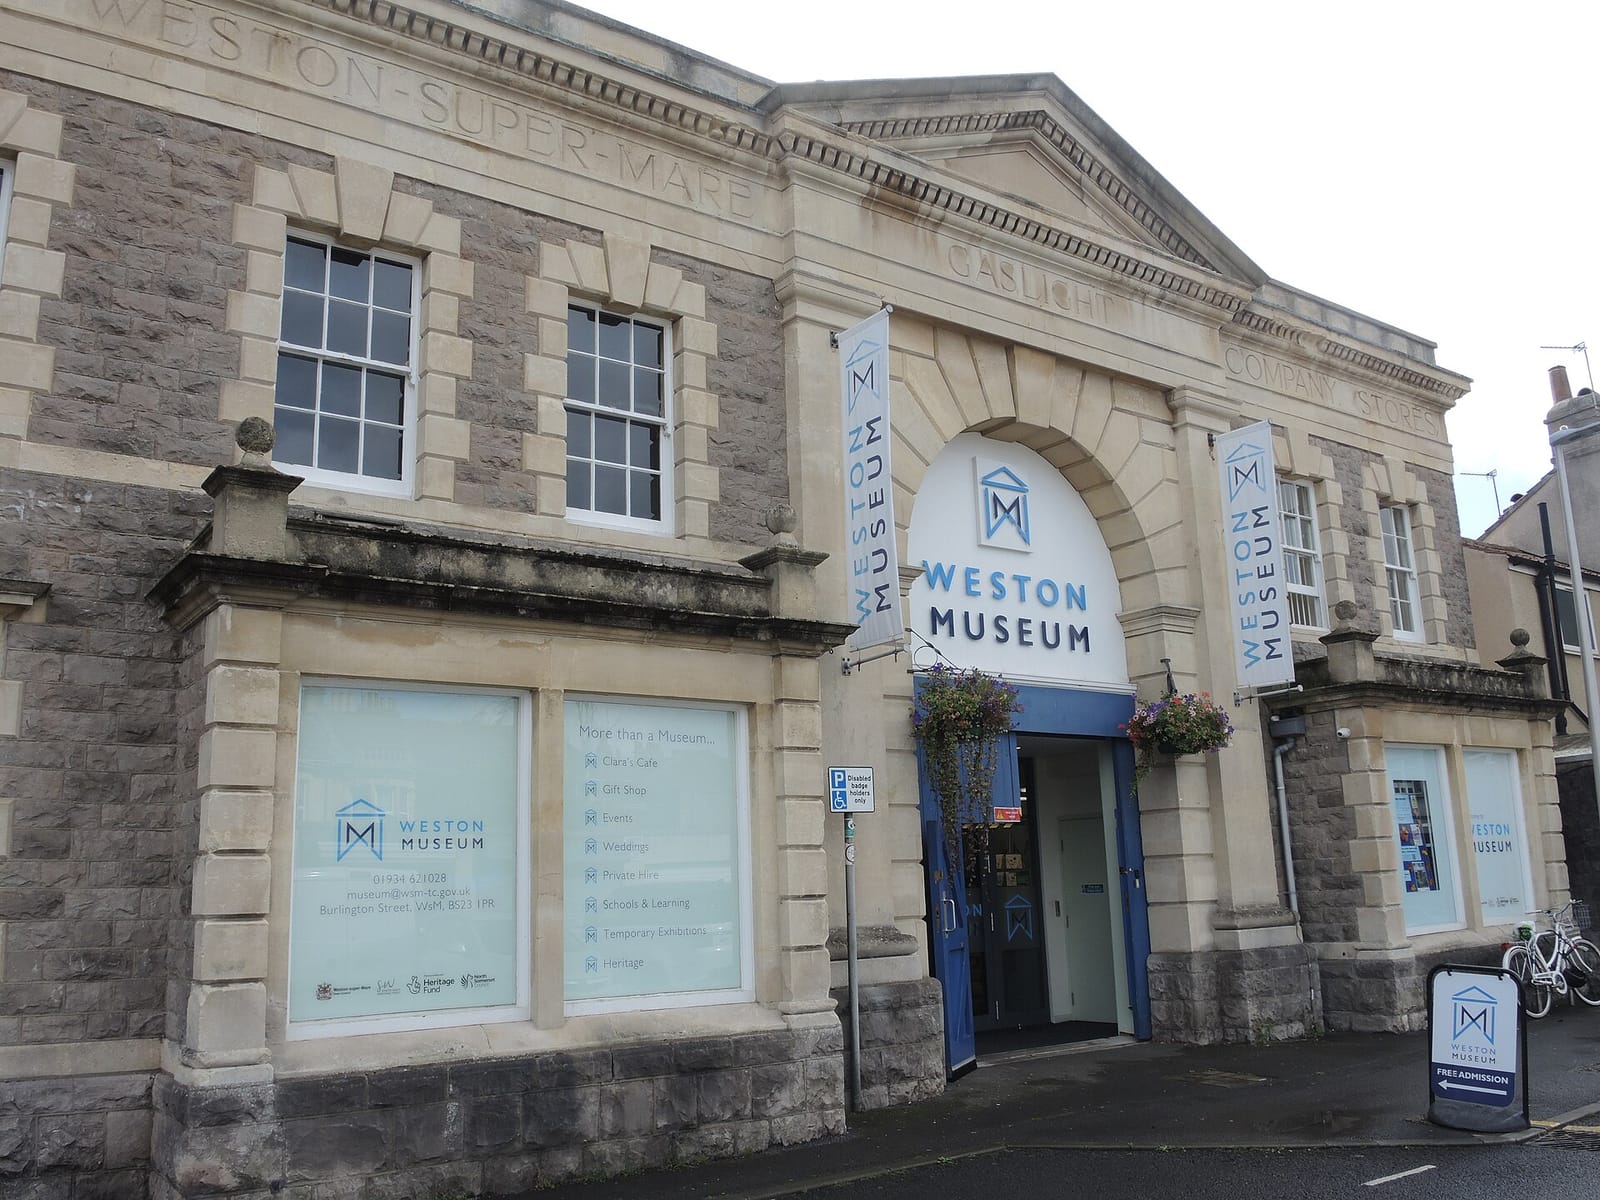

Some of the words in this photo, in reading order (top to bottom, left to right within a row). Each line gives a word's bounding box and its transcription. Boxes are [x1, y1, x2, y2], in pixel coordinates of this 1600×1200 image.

[947, 243, 1114, 324] GASLIGHT
[1224, 346, 1336, 405] COMPANY
[866, 416, 892, 612] MUSEUM
[849, 425, 872, 624] WESTON
[922, 559, 1087, 611] WESTON
[1251, 505, 1283, 660] MUSEUM
[1231, 511, 1262, 669] WESTON
[930, 606, 1090, 653] MUSEUM
[579, 725, 613, 739] More
[617, 728, 643, 741] than
[647, 732, 654, 741] a
[602, 756, 634, 767] Clara's
[834, 771, 844, 788] P
[602, 784, 621, 795] Gift
[623, 785, 647, 797] Shop
[602, 813, 633, 823] Events
[399, 820, 484, 833] WESTON
[402, 838, 484, 850] MUSEUM
[602, 841, 649, 853] Weddings
[373, 874, 405, 885] 01934
[409, 873, 447, 884] 621028
[603, 870, 636, 880] Private
[638, 869, 659, 880] Hire
[320, 902, 374, 917] Burlington
[448, 900, 473, 910] BS23
[602, 899, 639, 910] Schools
[641, 899, 648, 909] &
[651, 898, 690, 910] Learning
[603, 928, 655, 940] Temporary
[658, 926, 707, 937] Exhibitions
[603, 958, 644, 970] Heritage
[423, 978, 455, 987] Heritage
[423, 986, 441, 994] Fund
[1451, 1043, 1496, 1055] WESTON
[1451, 1053, 1496, 1065] MUSEUM
[1436, 1068, 1458, 1078] FREE
[1458, 1071, 1509, 1084] ADMISSION
